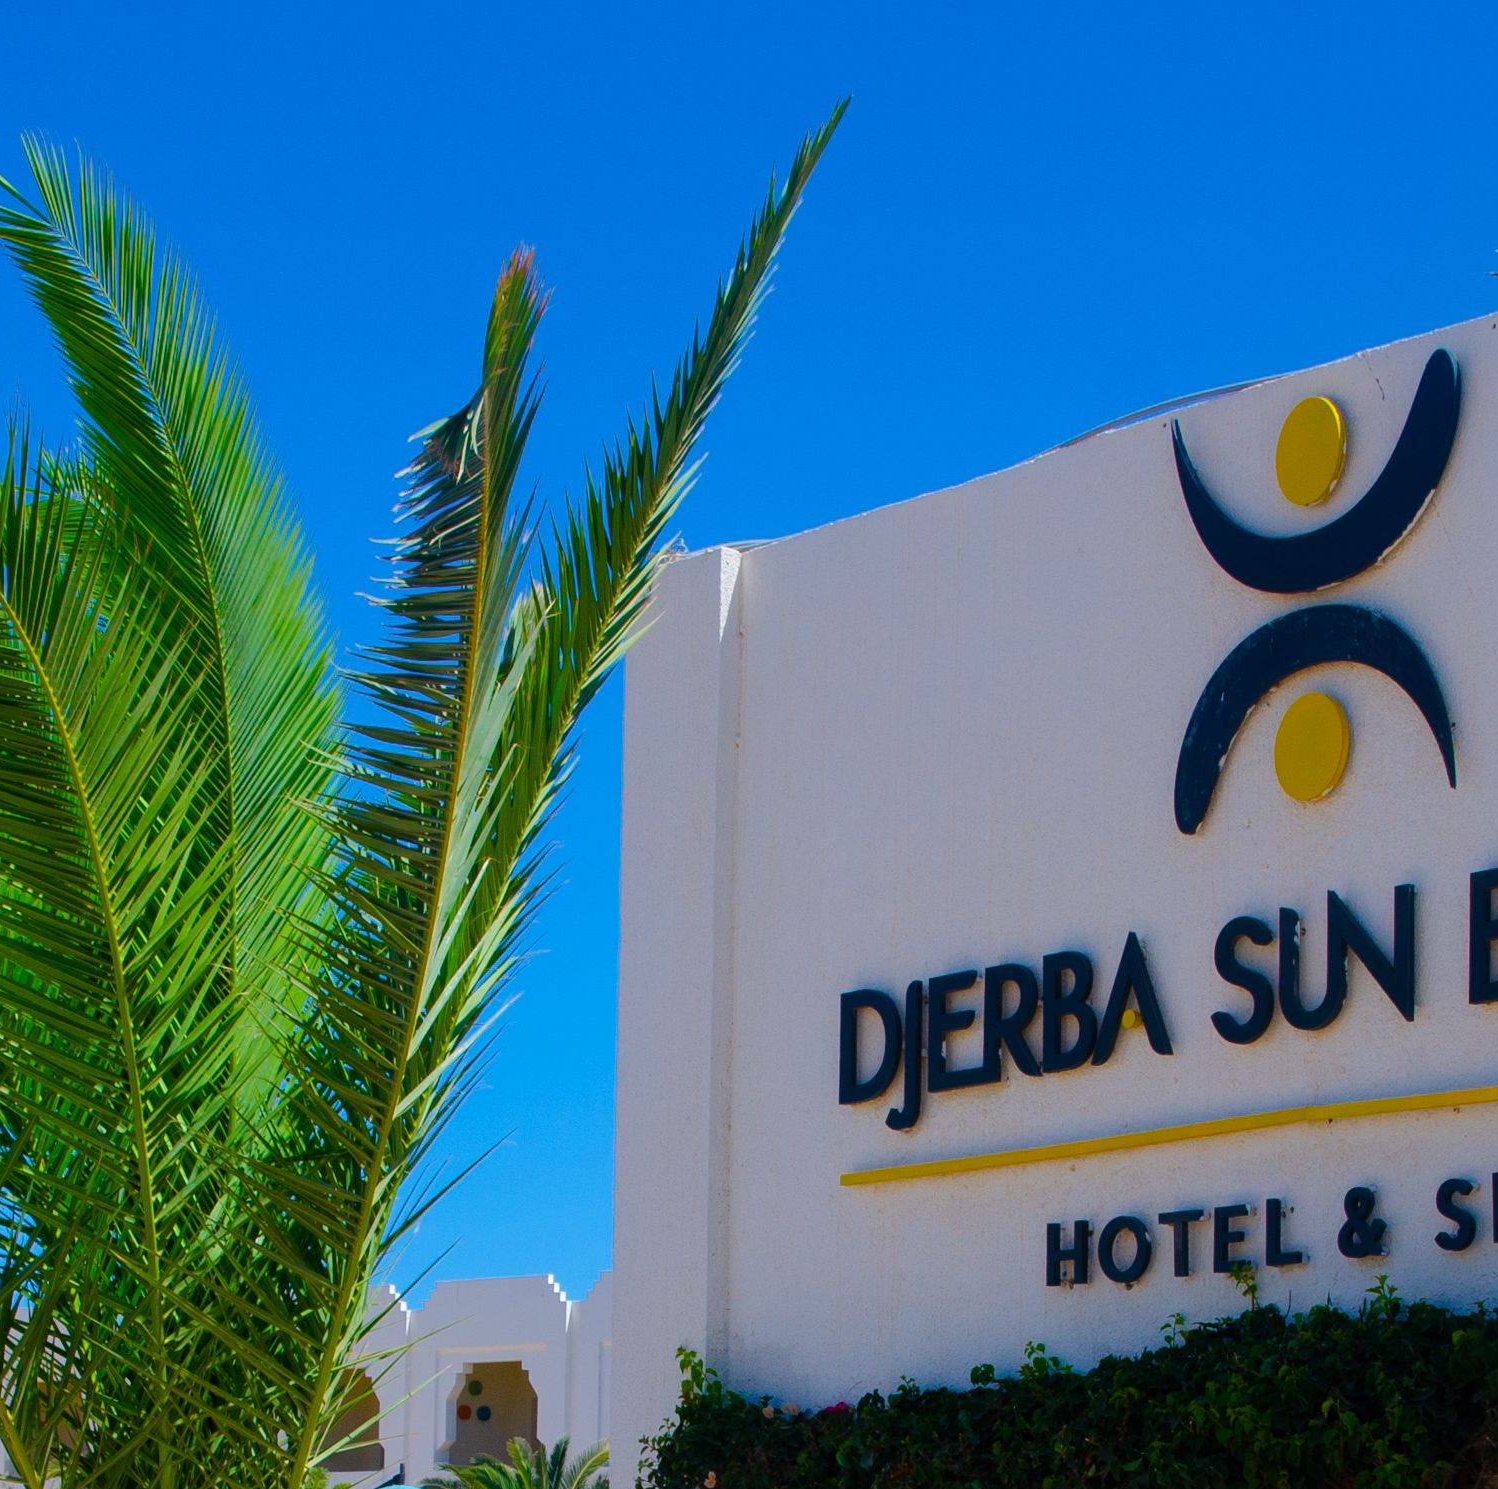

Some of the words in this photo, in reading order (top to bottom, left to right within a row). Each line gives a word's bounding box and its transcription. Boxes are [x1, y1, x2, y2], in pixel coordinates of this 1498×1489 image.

[837, 930, 1175, 1132] DJERBA
[1209, 881, 1420, 1046] SUN
[1045, 1196, 1313, 1290] HOTEL
[1336, 1185, 1393, 1260] &
